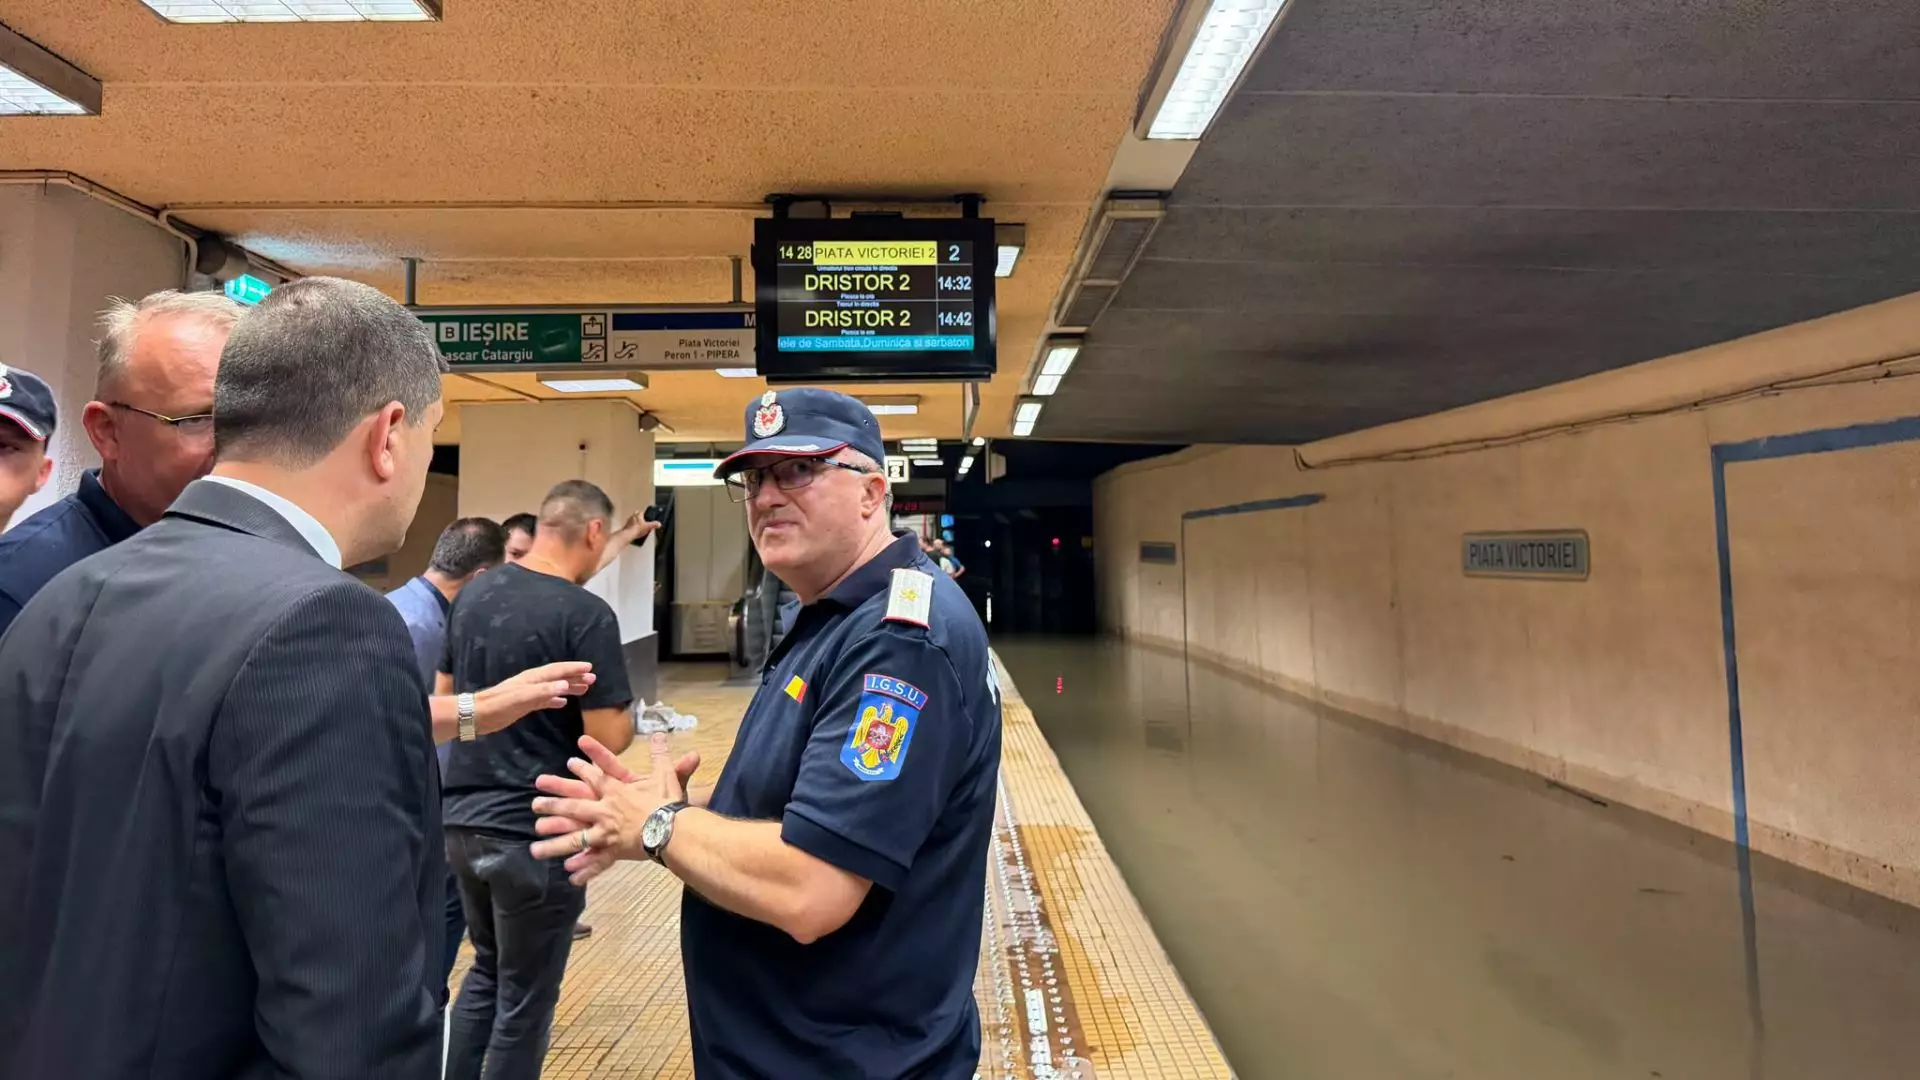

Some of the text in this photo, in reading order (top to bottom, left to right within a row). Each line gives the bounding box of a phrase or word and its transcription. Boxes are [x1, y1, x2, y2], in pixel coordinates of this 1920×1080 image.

[779, 246, 812, 259] 14 28
[815, 247, 936, 259] PIATA VICTORIEI 2
[949, 245, 960, 261] 2
[805, 274, 911, 291] DRISTOR 2
[938, 275, 972, 291] 14:32
[805, 310, 911, 327] DRISTOR 2
[938, 312, 972, 326] 14:42
[445, 327, 455, 339] B
[704, 337, 740, 348] Victoriei
[444, 348, 533, 363] ascar Catargiu
[664, 351, 691, 360] Peron
[706, 350, 740, 360] PIPERA
[1469, 541, 1577, 569] PIATA VICTORIEI
[870, 676, 920, 705] I.G.S.U.
